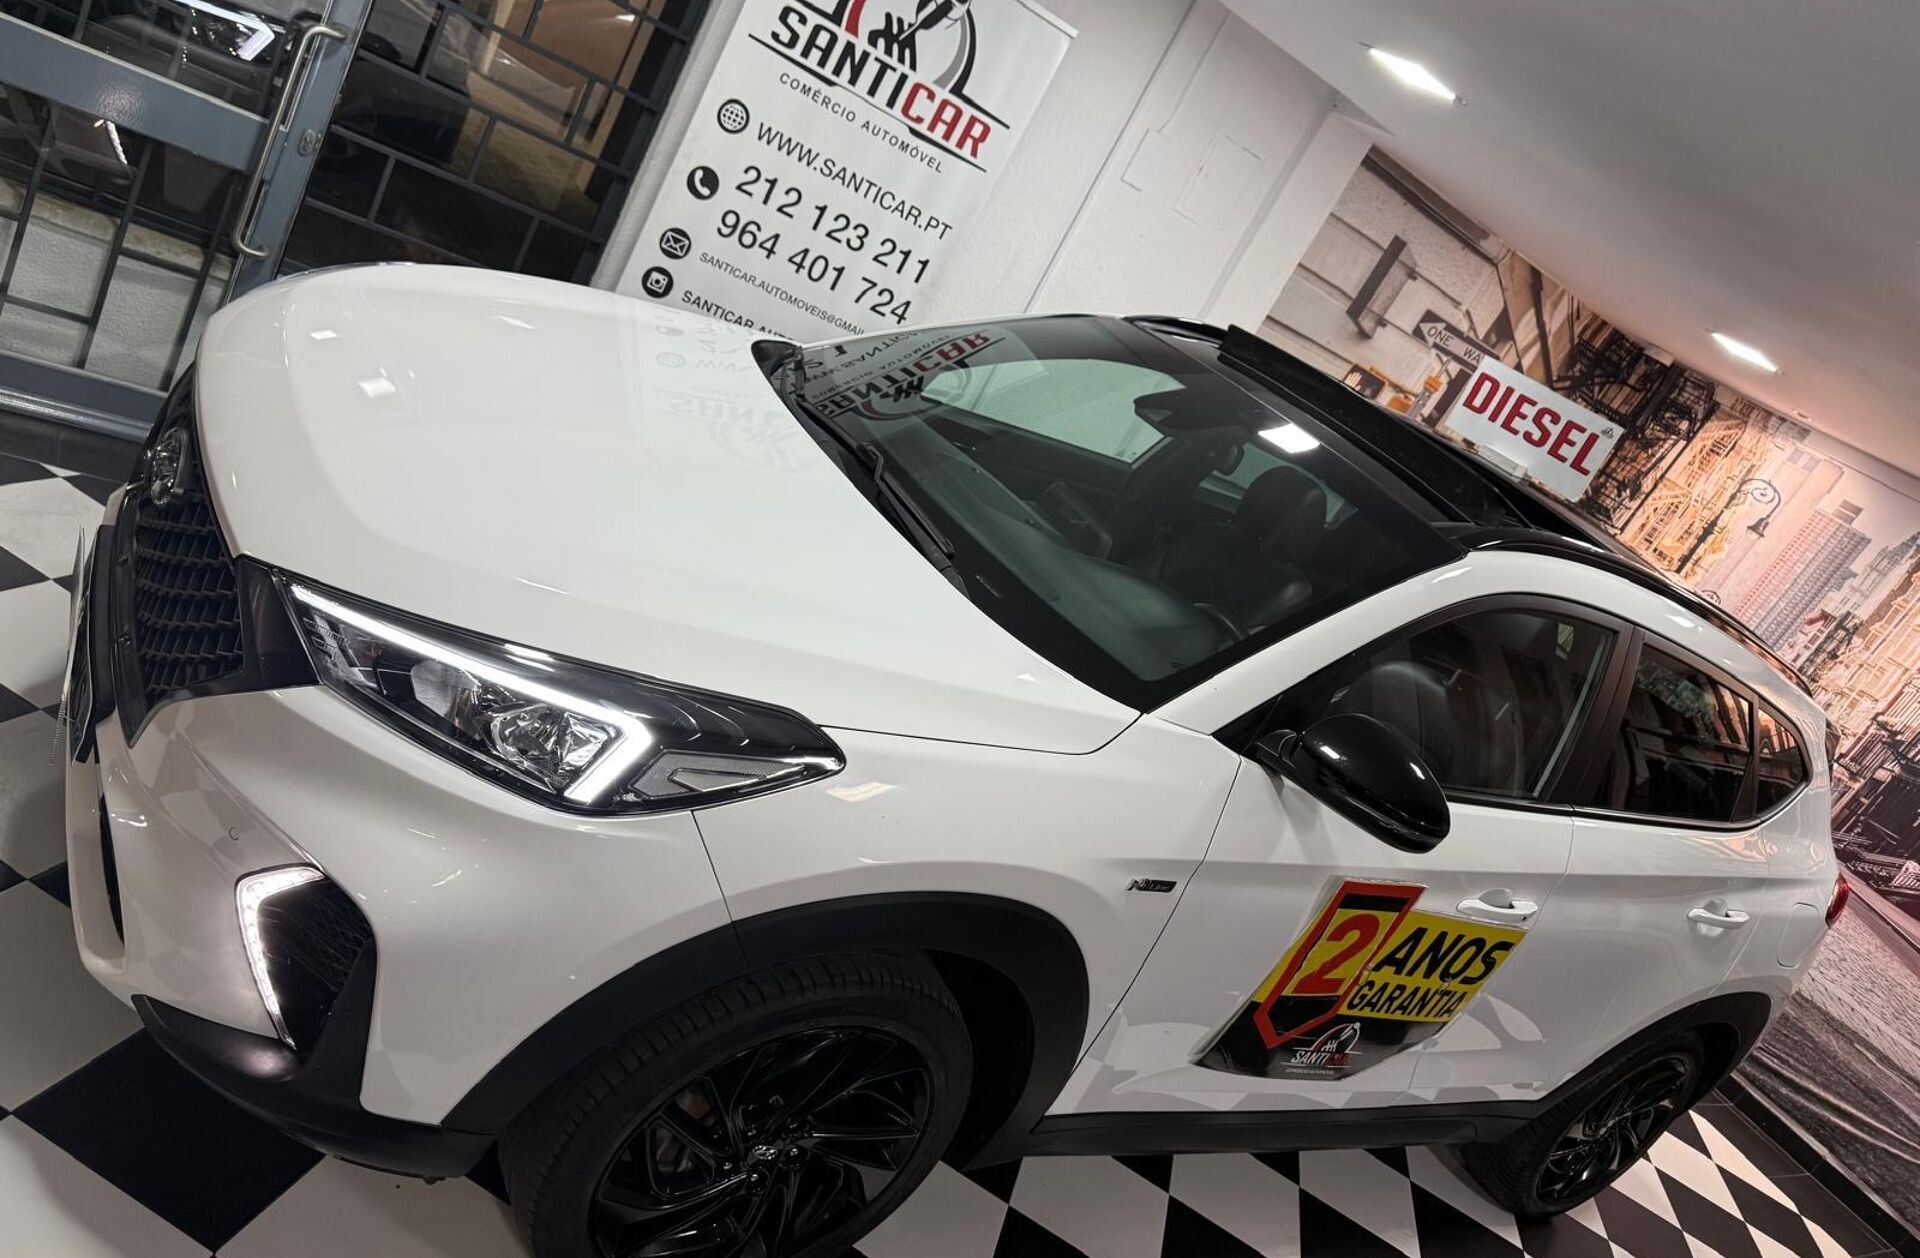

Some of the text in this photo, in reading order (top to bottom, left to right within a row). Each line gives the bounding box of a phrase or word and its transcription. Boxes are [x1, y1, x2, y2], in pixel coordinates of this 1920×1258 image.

[771, 6, 992, 159] SANTICAR
[779, 72, 943, 174] COMÉRCIO AUTOMÓVEL
[736, 165, 931, 285] 212 123 211
[757, 122, 953, 241] WWW.SANTICAR.PT
[716, 210, 913, 325] 964 401 724
[1427, 325, 1485, 365] ONE WA
[1462, 371, 1600, 477] DIESEL
[1291, 914, 1516, 995] 2 ANOS
[1346, 980, 1468, 1018] GARANTIA
